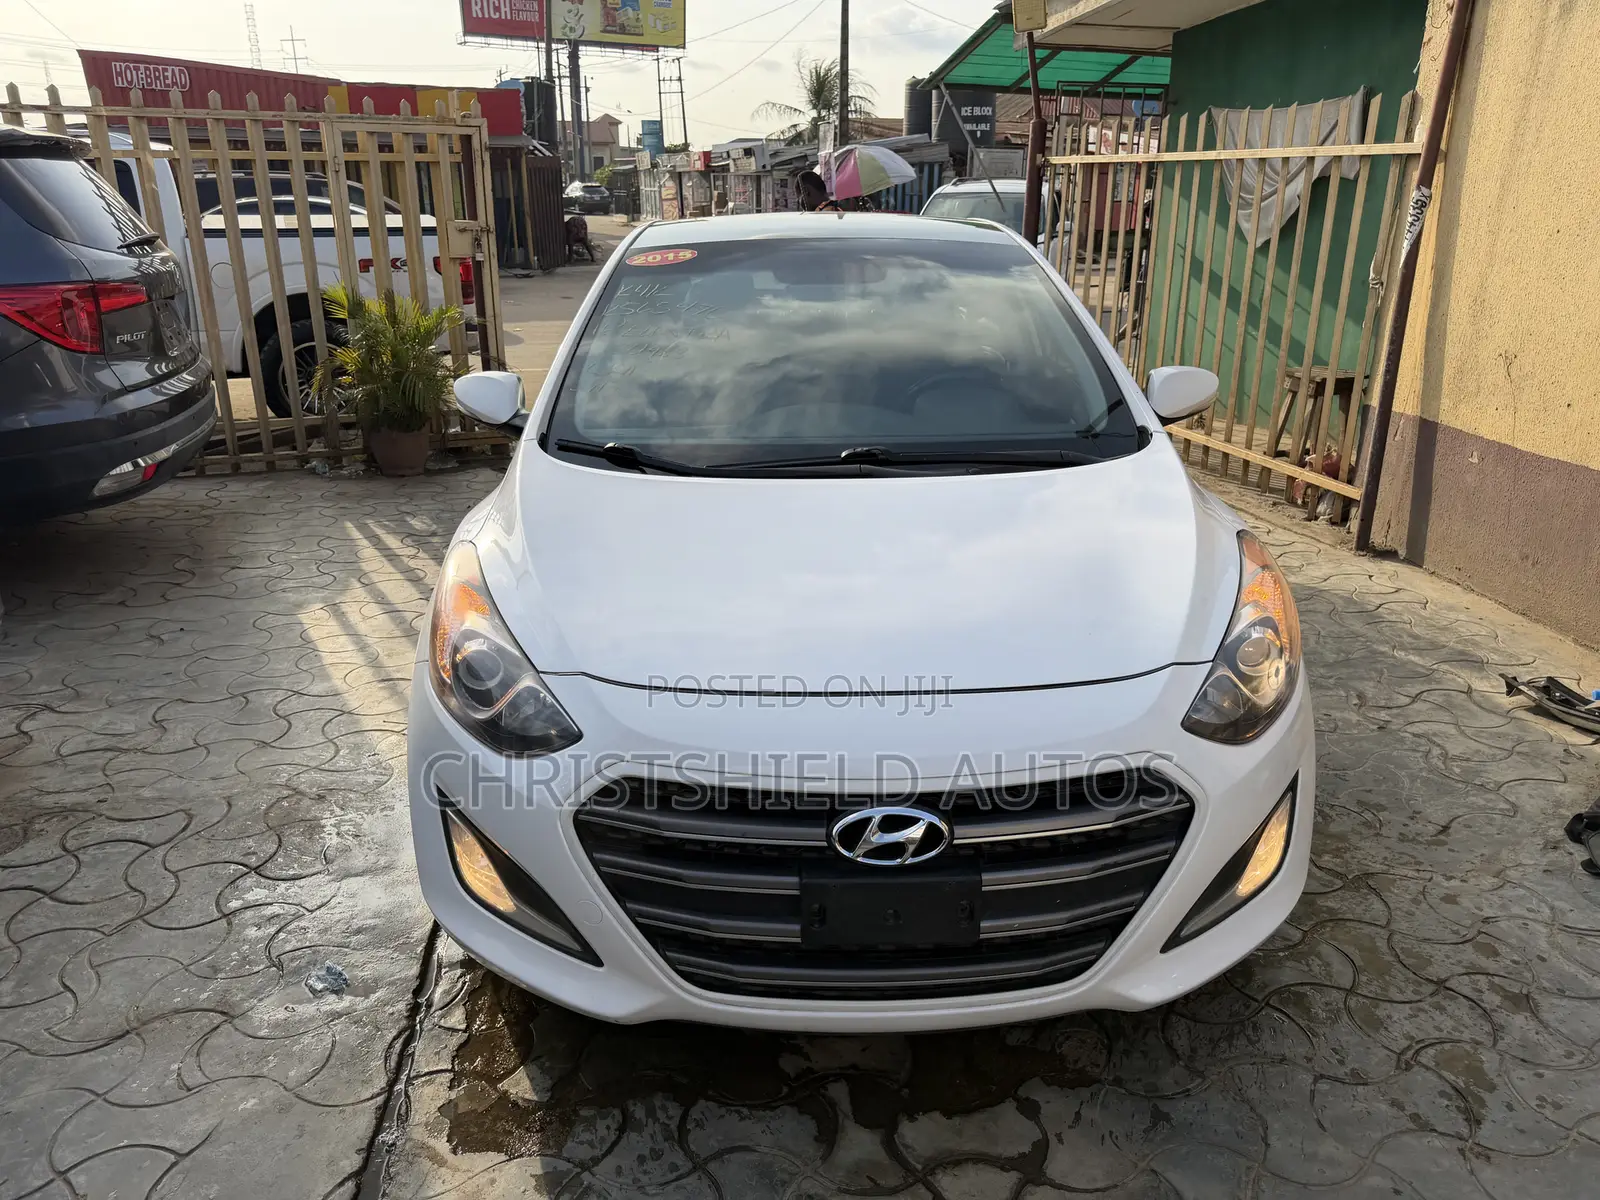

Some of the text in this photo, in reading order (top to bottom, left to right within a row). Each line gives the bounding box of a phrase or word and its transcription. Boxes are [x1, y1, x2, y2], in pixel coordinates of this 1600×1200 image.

[471, 0, 511, 20] RICH
[512, 11, 539, 22] FLAVOUR
[961, 106, 993, 116] ICE BLOCK
[632, 251, 692, 264] 2015
[116, 331, 147, 344] PILOT
